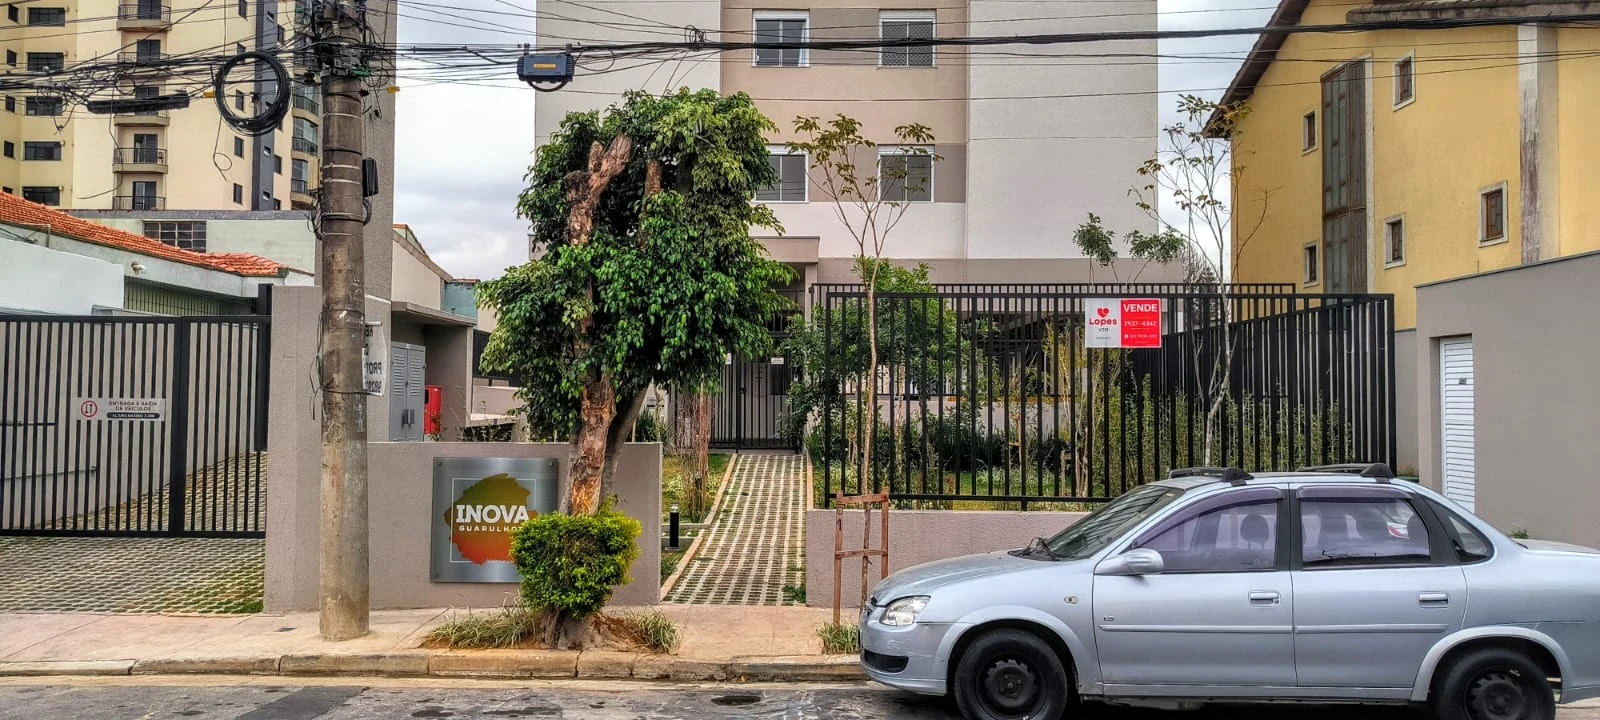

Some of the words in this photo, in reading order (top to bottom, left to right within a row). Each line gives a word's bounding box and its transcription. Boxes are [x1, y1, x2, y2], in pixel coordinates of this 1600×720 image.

[1123, 303, 1158, 313] VENDE
[1089, 318, 1117, 327] Lopes
[455, 504, 529, 523] INOVA
